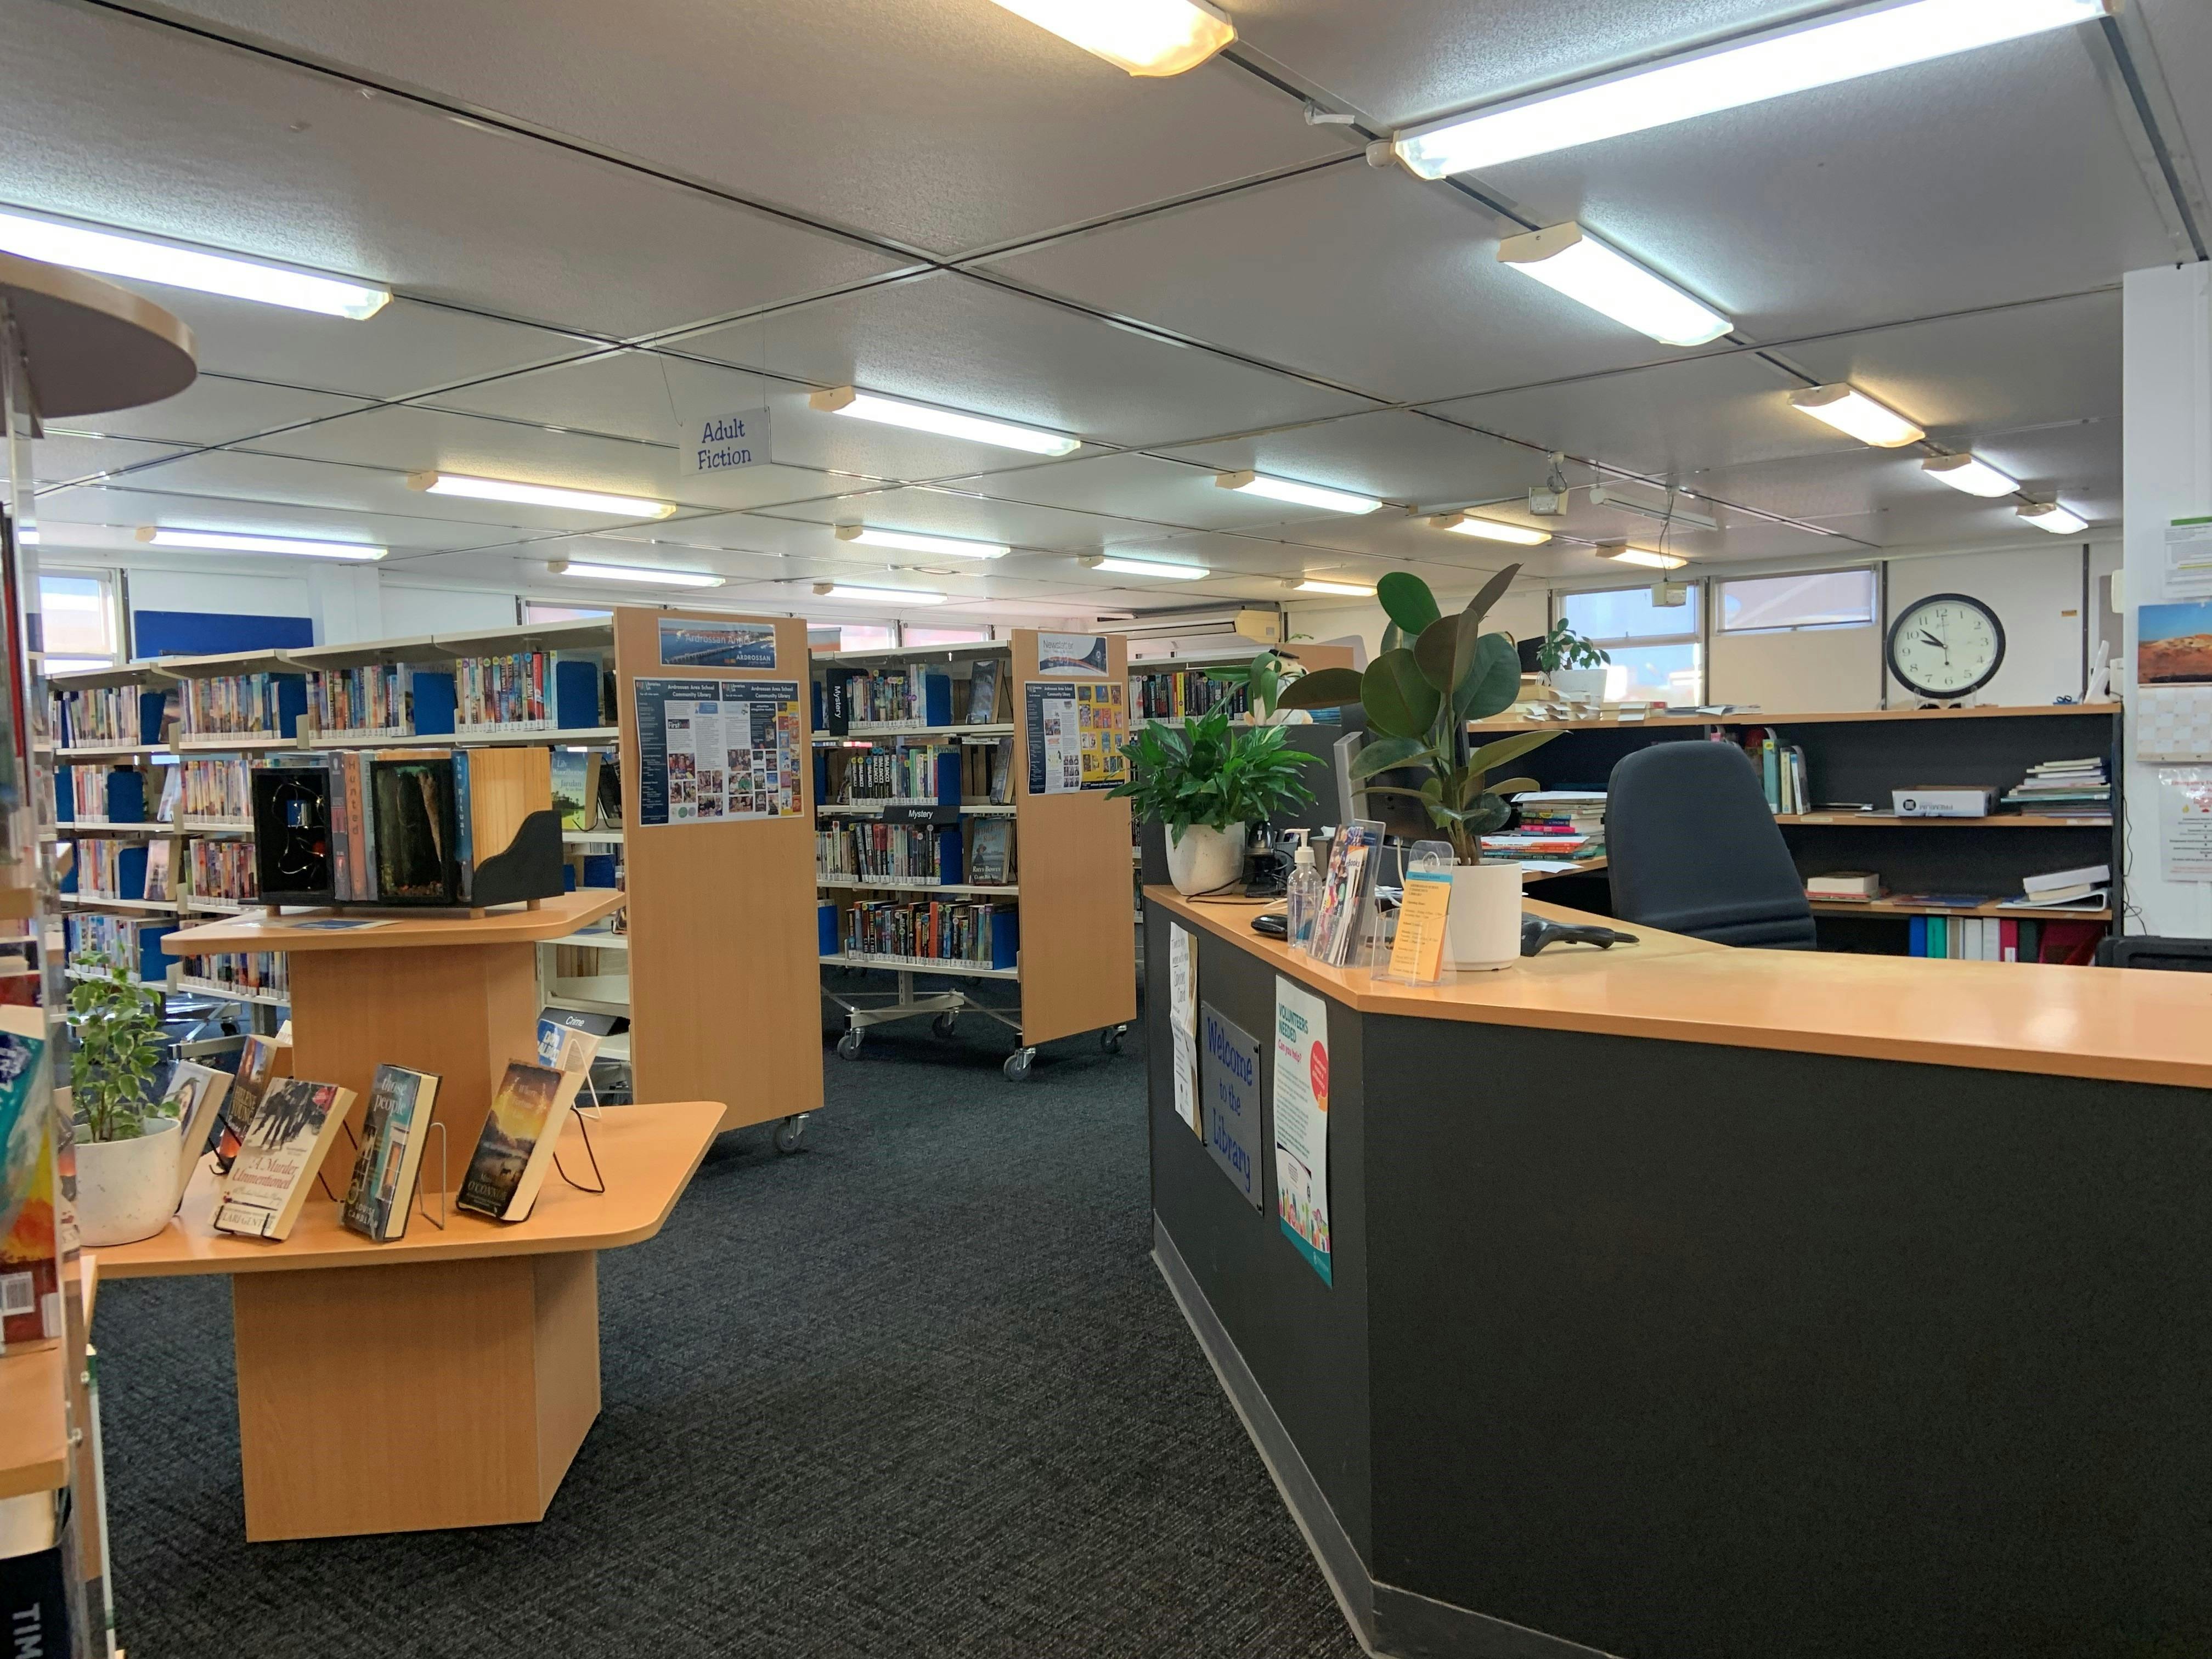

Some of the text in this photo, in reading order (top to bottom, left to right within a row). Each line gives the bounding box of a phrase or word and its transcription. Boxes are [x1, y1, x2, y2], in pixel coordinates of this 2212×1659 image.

[702, 418, 746, 443] Adult
[698, 447, 752, 470] Fiction
[1936, 609, 1948, 618] 12
[1960, 611, 1963, 619] 1
[1919, 616, 1928, 625] 11
[1973, 621, 1982, 630] 2
[686, 634, 726, 644] Ardrossan
[1906, 631, 1919, 640] 10
[1043, 640, 1074, 650] Newsletter
[1980, 637, 1989, 646] 3
[1902, 647, 1910, 656] 9
[1910, 663, 1918, 672] 8
[1925, 674, 1933, 683] 7
[1963, 669, 1972, 679] 5
[1944, 676, 1953, 685] 6
[833, 686, 842, 718] Mystery
[668, 720, 680, 729] First
[348, 759, 359, 835] Hunted
[909, 809, 934, 820] Mystery
[566, 1015, 585, 1027] Crime
[1278, 1003, 1309, 1035] VOLUNTEERS
[1278, 1020, 1297, 1043] NEEDED
[1207, 1016, 1252, 1086] Welcome
[1291, 1048, 1302, 1064] help?
[382, 1073, 408, 1096] those
[1219, 1077, 1241, 1117] to the
[373, 1094, 406, 1116] people
[1212, 1107, 1251, 1194] Library
[249, 1157, 300, 1175] A Murder
[232, 1166, 295, 1190] Unmentioned
